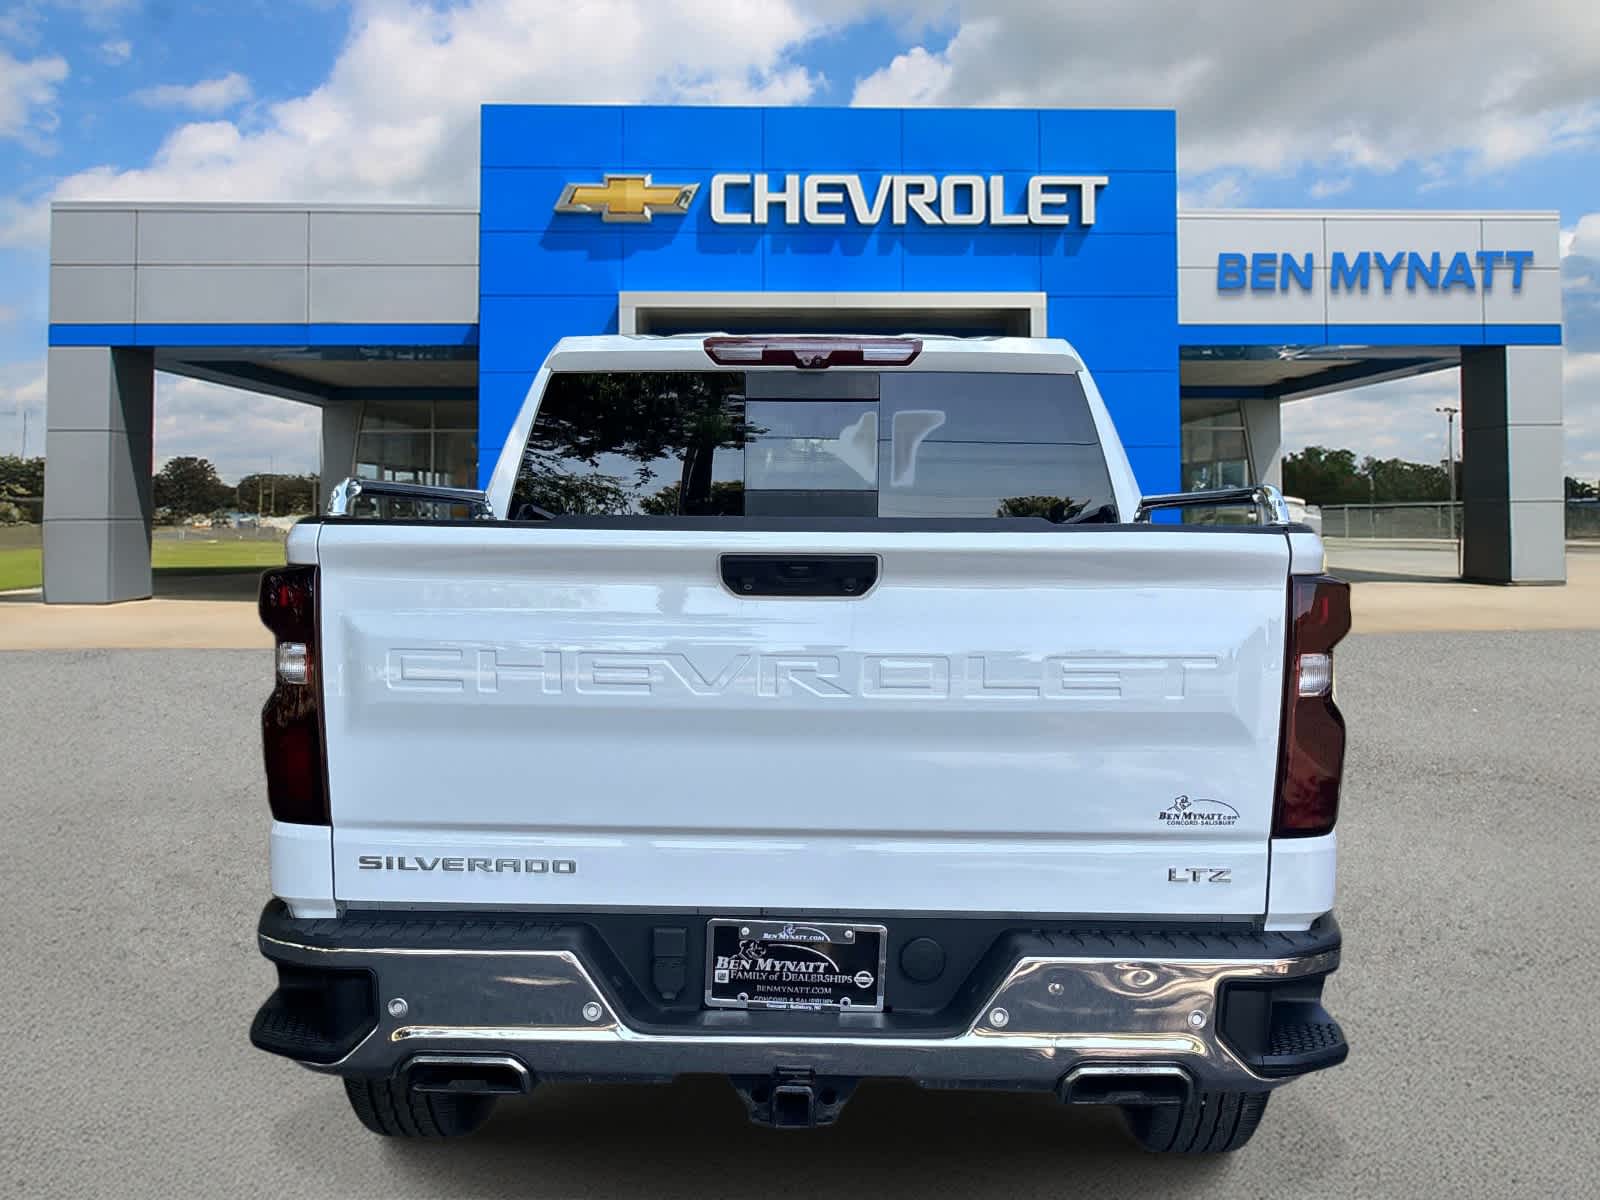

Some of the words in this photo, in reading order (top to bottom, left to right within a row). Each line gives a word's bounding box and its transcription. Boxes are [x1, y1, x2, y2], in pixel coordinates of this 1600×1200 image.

[710, 173, 1109, 226] CHEVROLET
[1217, 252, 1313, 291] BEN
[1330, 250, 1534, 291] MYNATT
[386, 647, 1219, 700] CHEVROLET
[358, 855, 577, 875] SILVERADO
[1168, 868, 1232, 883] LTZ
[715, 956, 752, 970] BEN
[756, 958, 828, 973] MYNATT
[730, 970, 769, 981] FAMILY
[783, 971, 853, 984] DEALERSHIPS
[756, 984, 832, 994] BENMYNATT.COM
